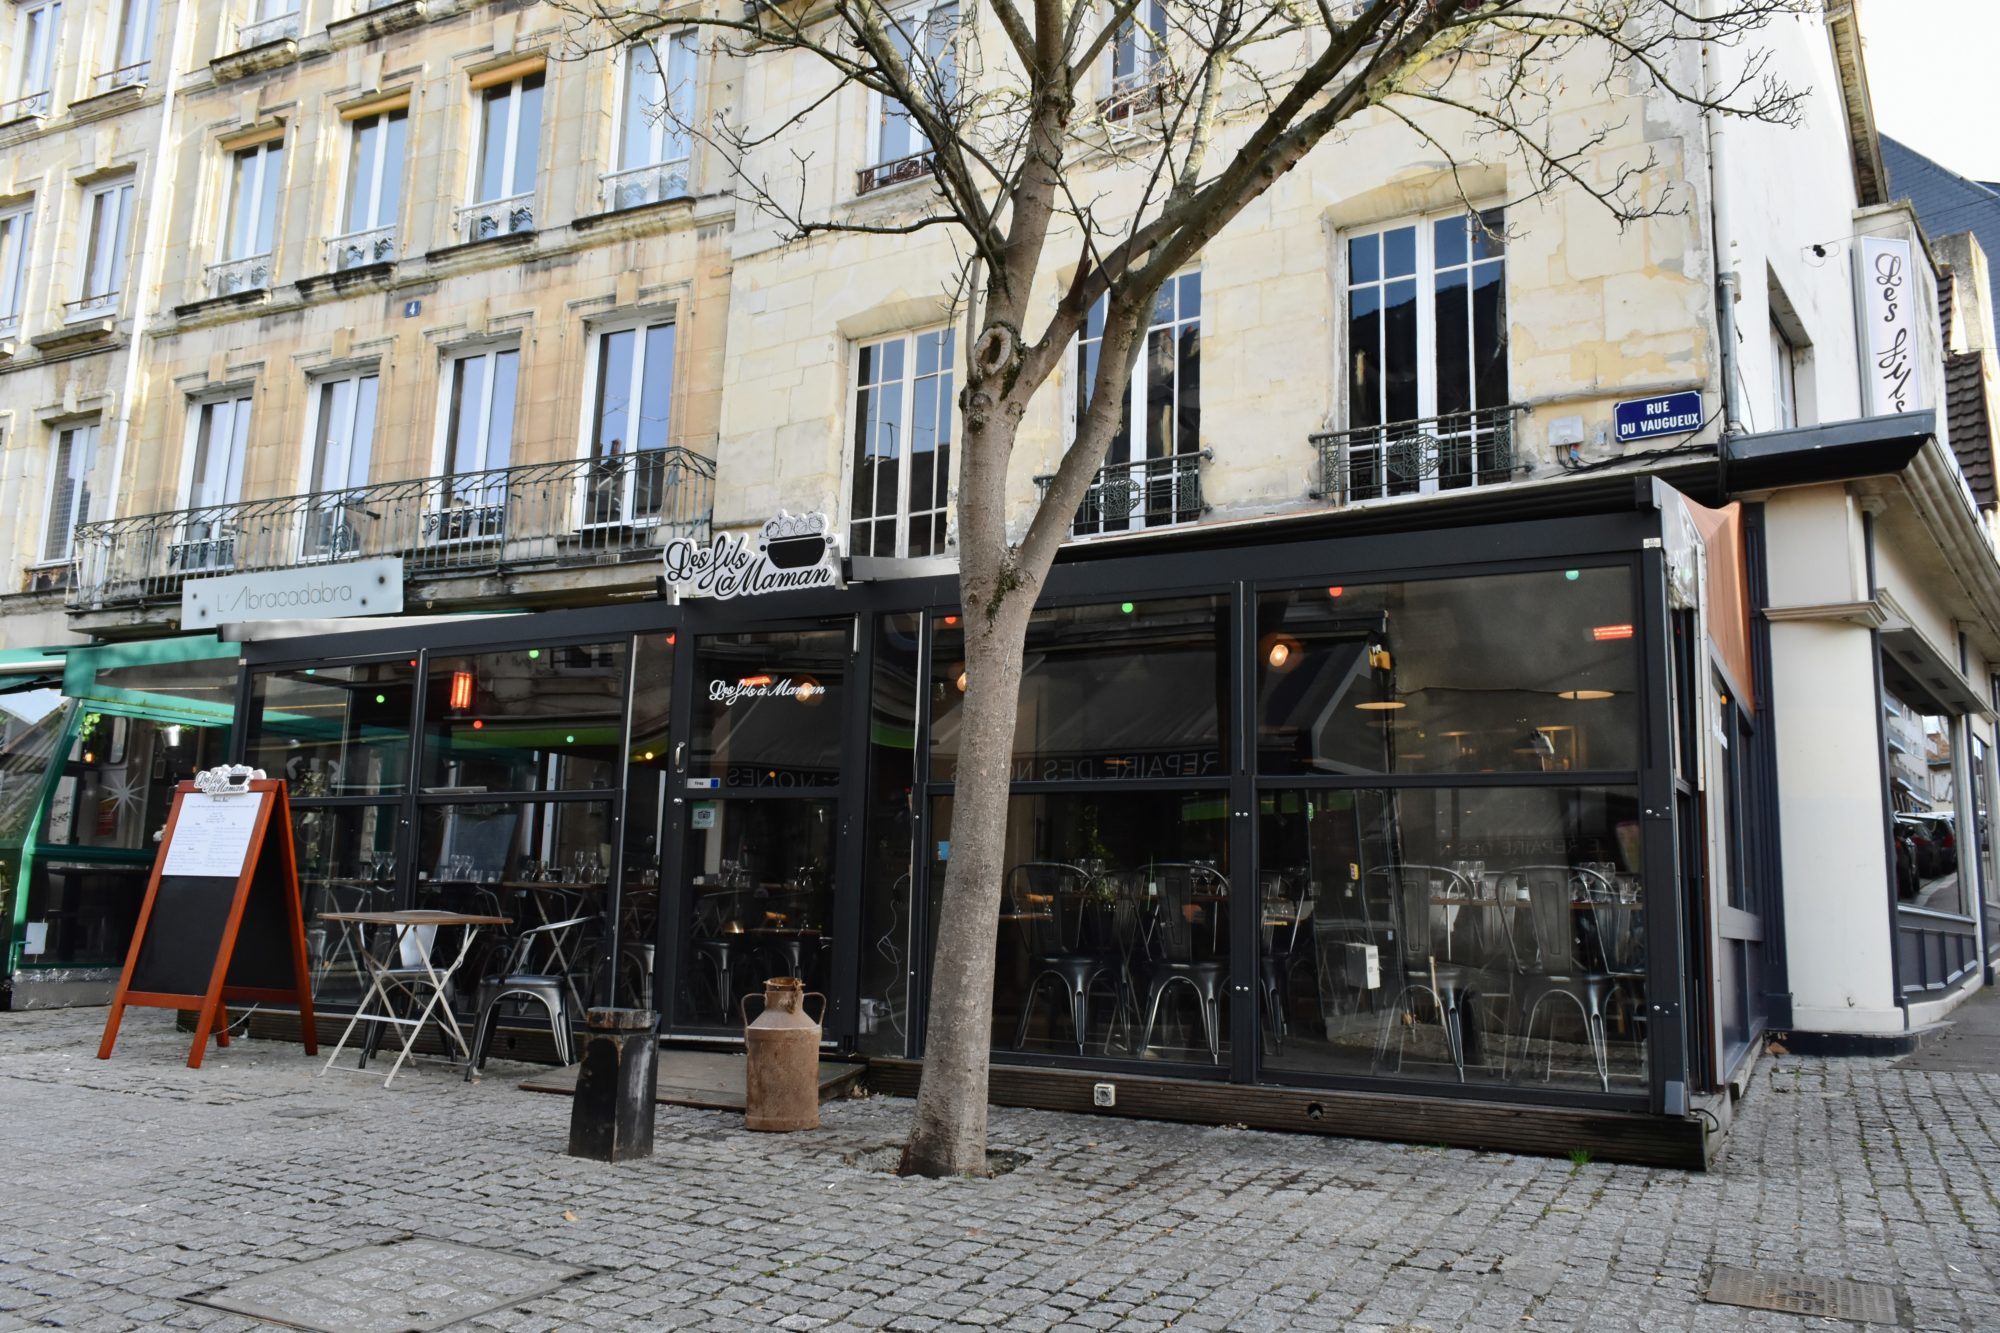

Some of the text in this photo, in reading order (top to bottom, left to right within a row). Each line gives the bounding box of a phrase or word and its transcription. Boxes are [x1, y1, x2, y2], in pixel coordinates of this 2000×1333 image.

[409, 302, 416, 315] 4
[1875, 252, 1912, 413] Les fils
[1646, 401, 1670, 416] RUE
[1621, 413, 1699, 436] DU VAUGUEUX
[666, 535, 750, 590] Les fils
[740, 554, 831, 594] Maman
[709, 678, 826, 706] Les fils à Maman
